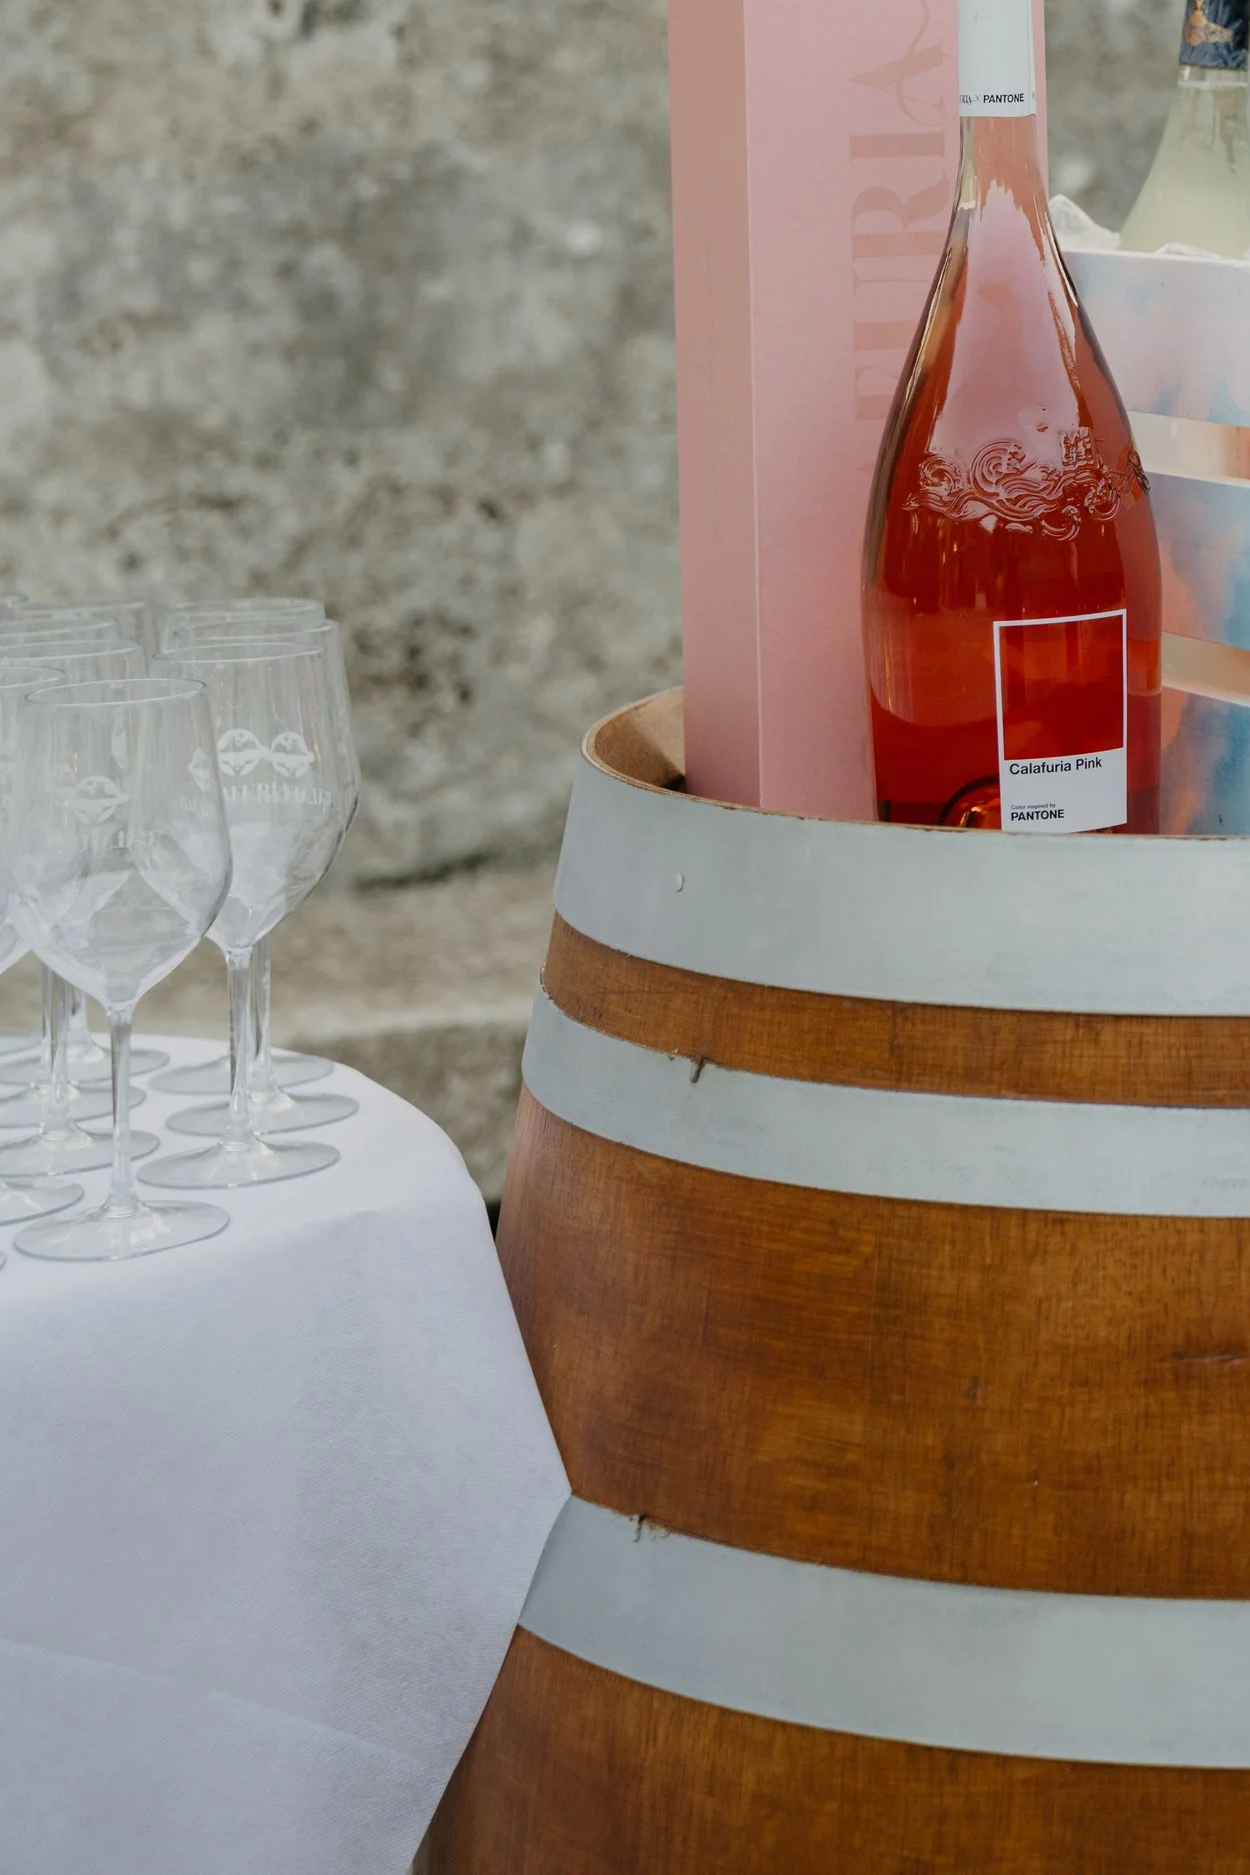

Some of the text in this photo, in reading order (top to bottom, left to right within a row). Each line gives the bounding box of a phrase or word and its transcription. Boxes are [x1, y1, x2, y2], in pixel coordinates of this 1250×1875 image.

[983, 93, 1024, 103] PANTONE
[1009, 757, 1102, 775] Calafuria Pink
[1011, 809, 1064, 821] PANTONE
